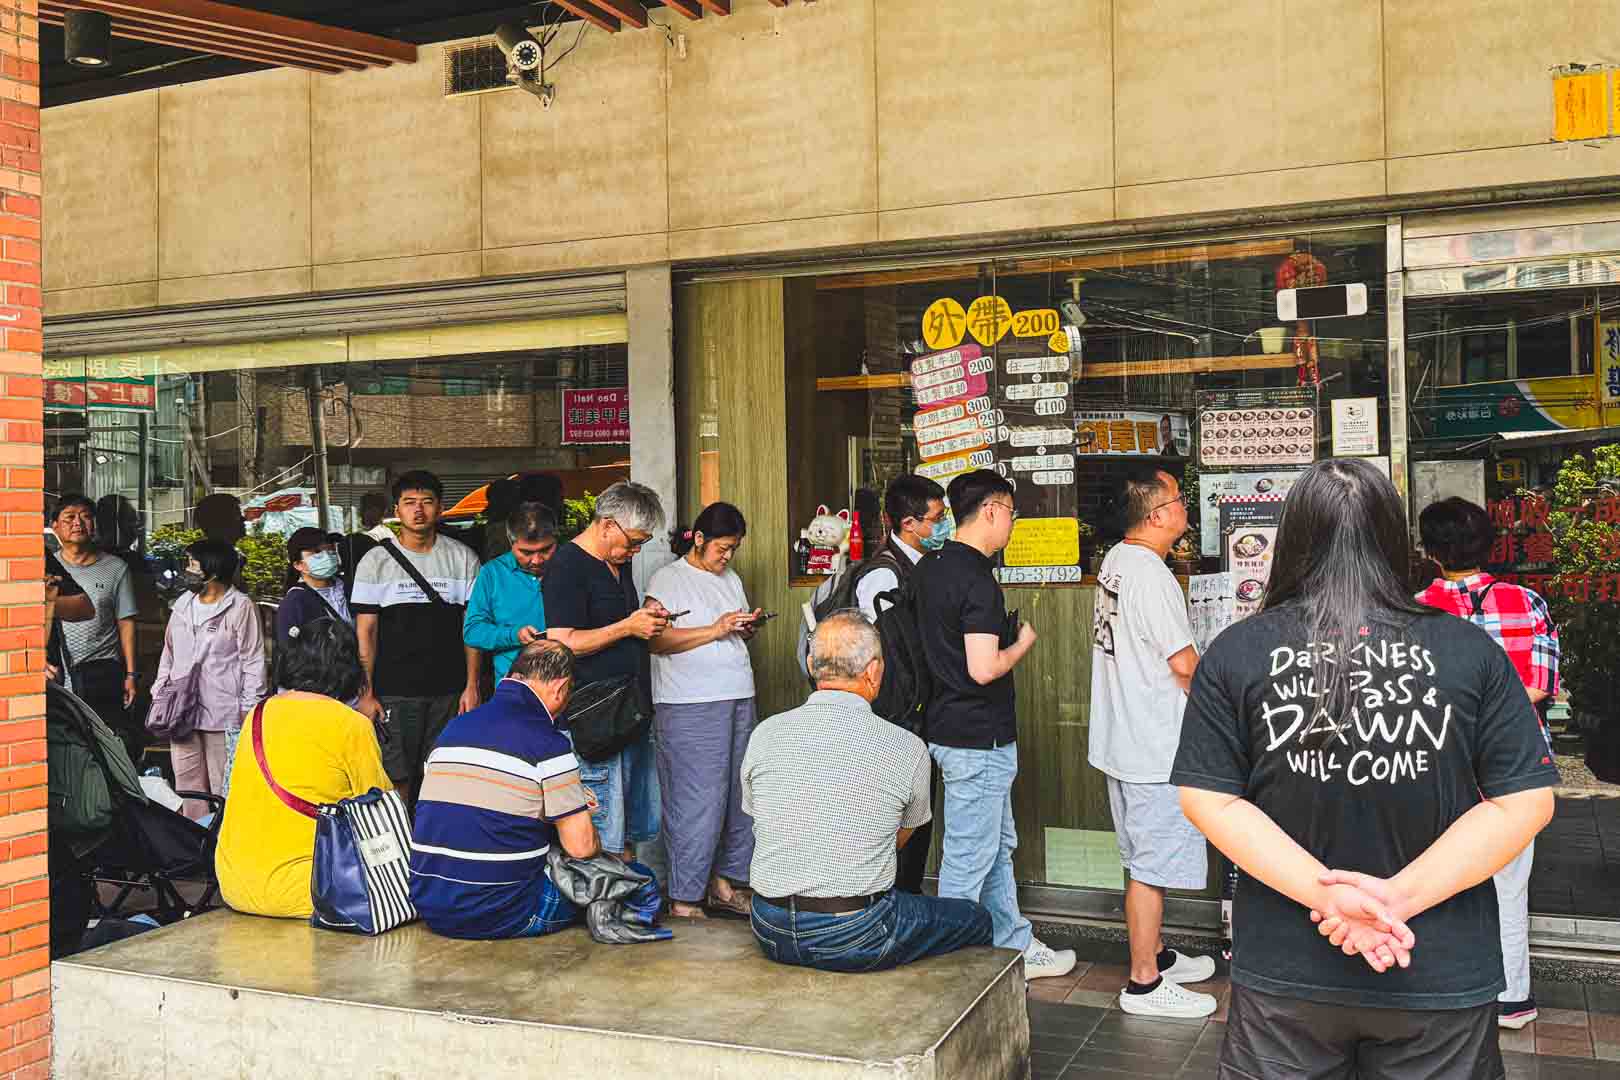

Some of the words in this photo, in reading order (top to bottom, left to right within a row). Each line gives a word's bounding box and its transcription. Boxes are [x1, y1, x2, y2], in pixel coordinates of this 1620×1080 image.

[928, 300, 1010, 346] 外帶
[1016, 312, 1056, 335] 200
[969, 358, 992, 374] 200
[967, 399, 990, 413] 300
[969, 452, 992, 466] 300
[1262, 701, 1451, 751] DAWN
